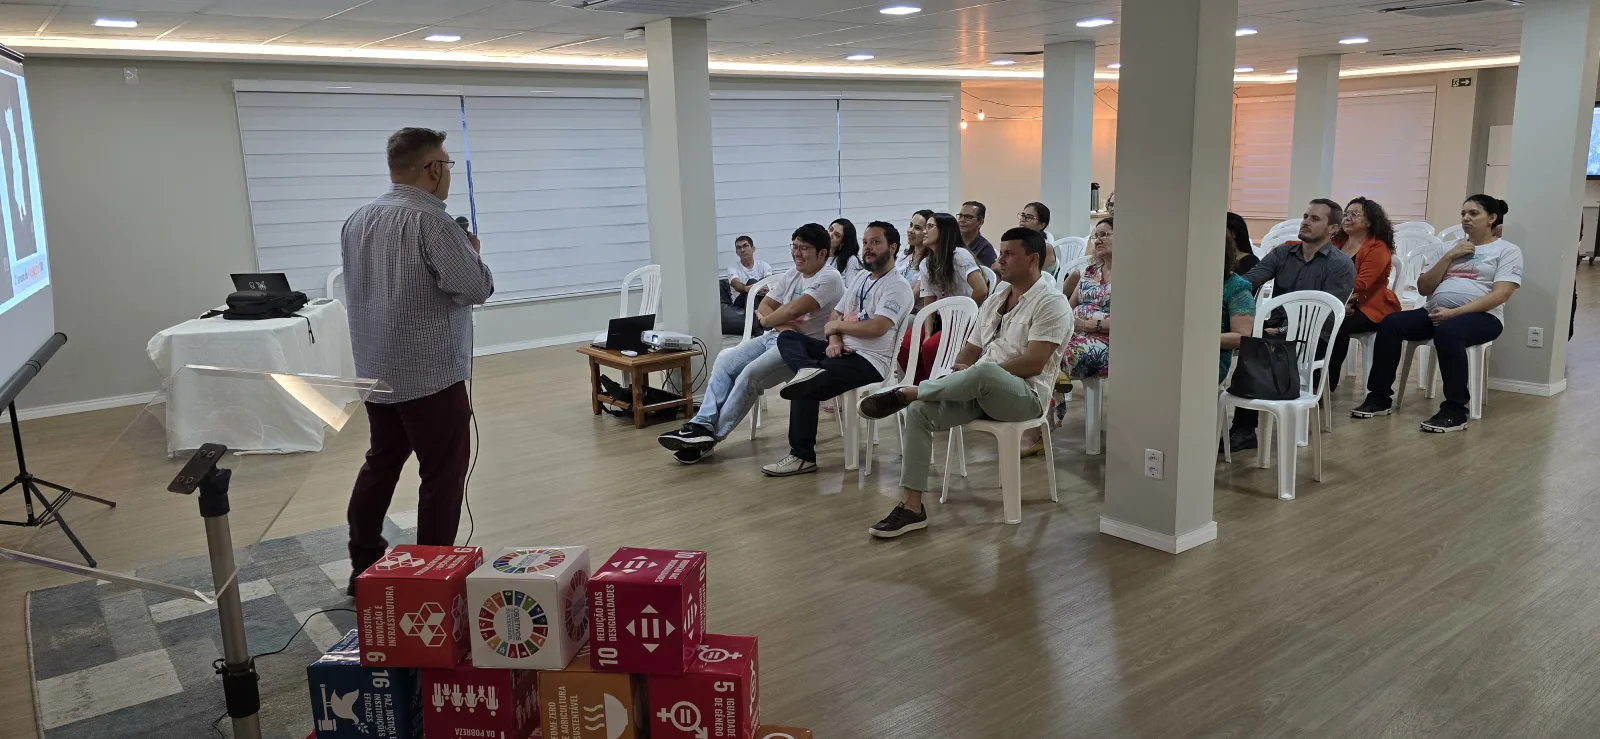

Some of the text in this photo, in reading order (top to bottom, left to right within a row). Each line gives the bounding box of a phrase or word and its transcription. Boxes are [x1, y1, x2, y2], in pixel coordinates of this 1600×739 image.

[363, 606, 373, 646] INDÚSTRIA,
[374, 611, 386, 647] INOVAÇÃO
[385, 586, 396, 647] INFRAESTRUTURA
[594, 591, 606, 642] REDUÇÃO DAS
[606, 584, 617, 642] DESIGUALDADES
[366, 652, 387, 662] 9
[598, 647, 618, 667] 10
[372, 670, 390, 688] 16
[714, 681, 735, 692] 5
[363, 693, 373, 723] EFICAZES
[374, 693, 386, 737] INSTITUIÇÕES
[384, 693, 393, 708] PAZ,
[558, 686, 569, 734] AGRICULTURA
[569, 694, 581, 739] SUSTENTÁVEL
[714, 697, 723, 707] DE
[726, 698, 736, 737] IGUALDADE
[385, 709, 396, 735] JUSTIÇA
[454, 728, 485, 737] POBREZA
[548, 702, 558, 739] FOME ZERO
